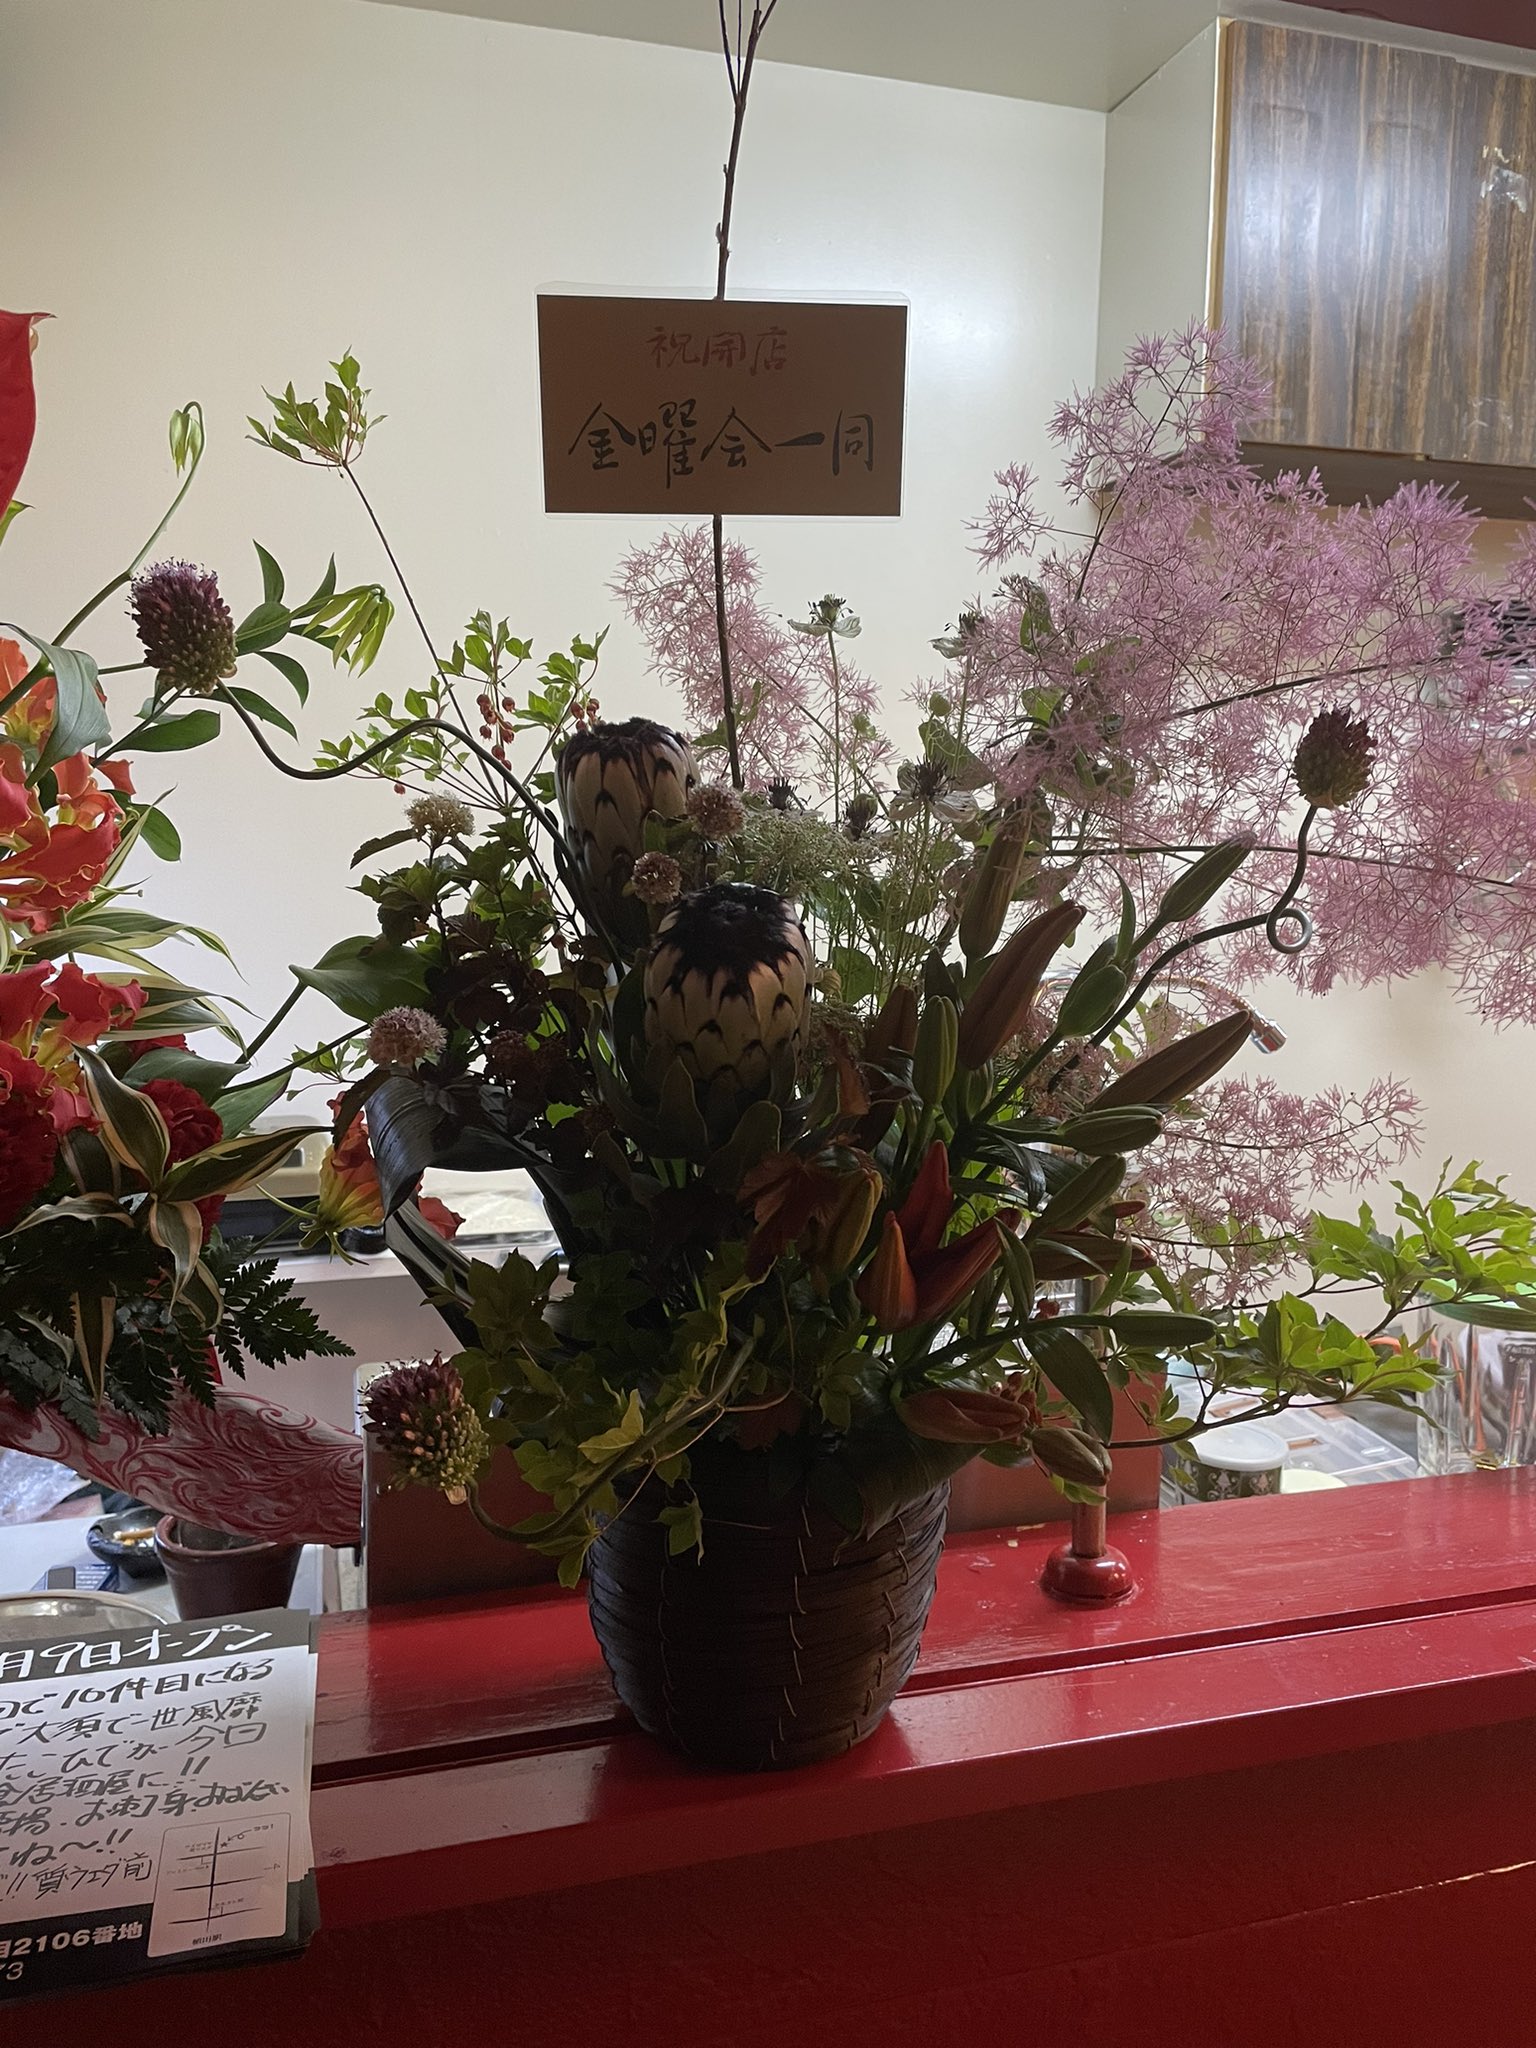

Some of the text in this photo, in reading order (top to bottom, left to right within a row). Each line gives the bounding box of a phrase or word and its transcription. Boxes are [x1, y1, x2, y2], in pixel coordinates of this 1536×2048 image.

[646, 326, 788, 376] 祝開店
[568, 398, 874, 490] 金曜会一同
